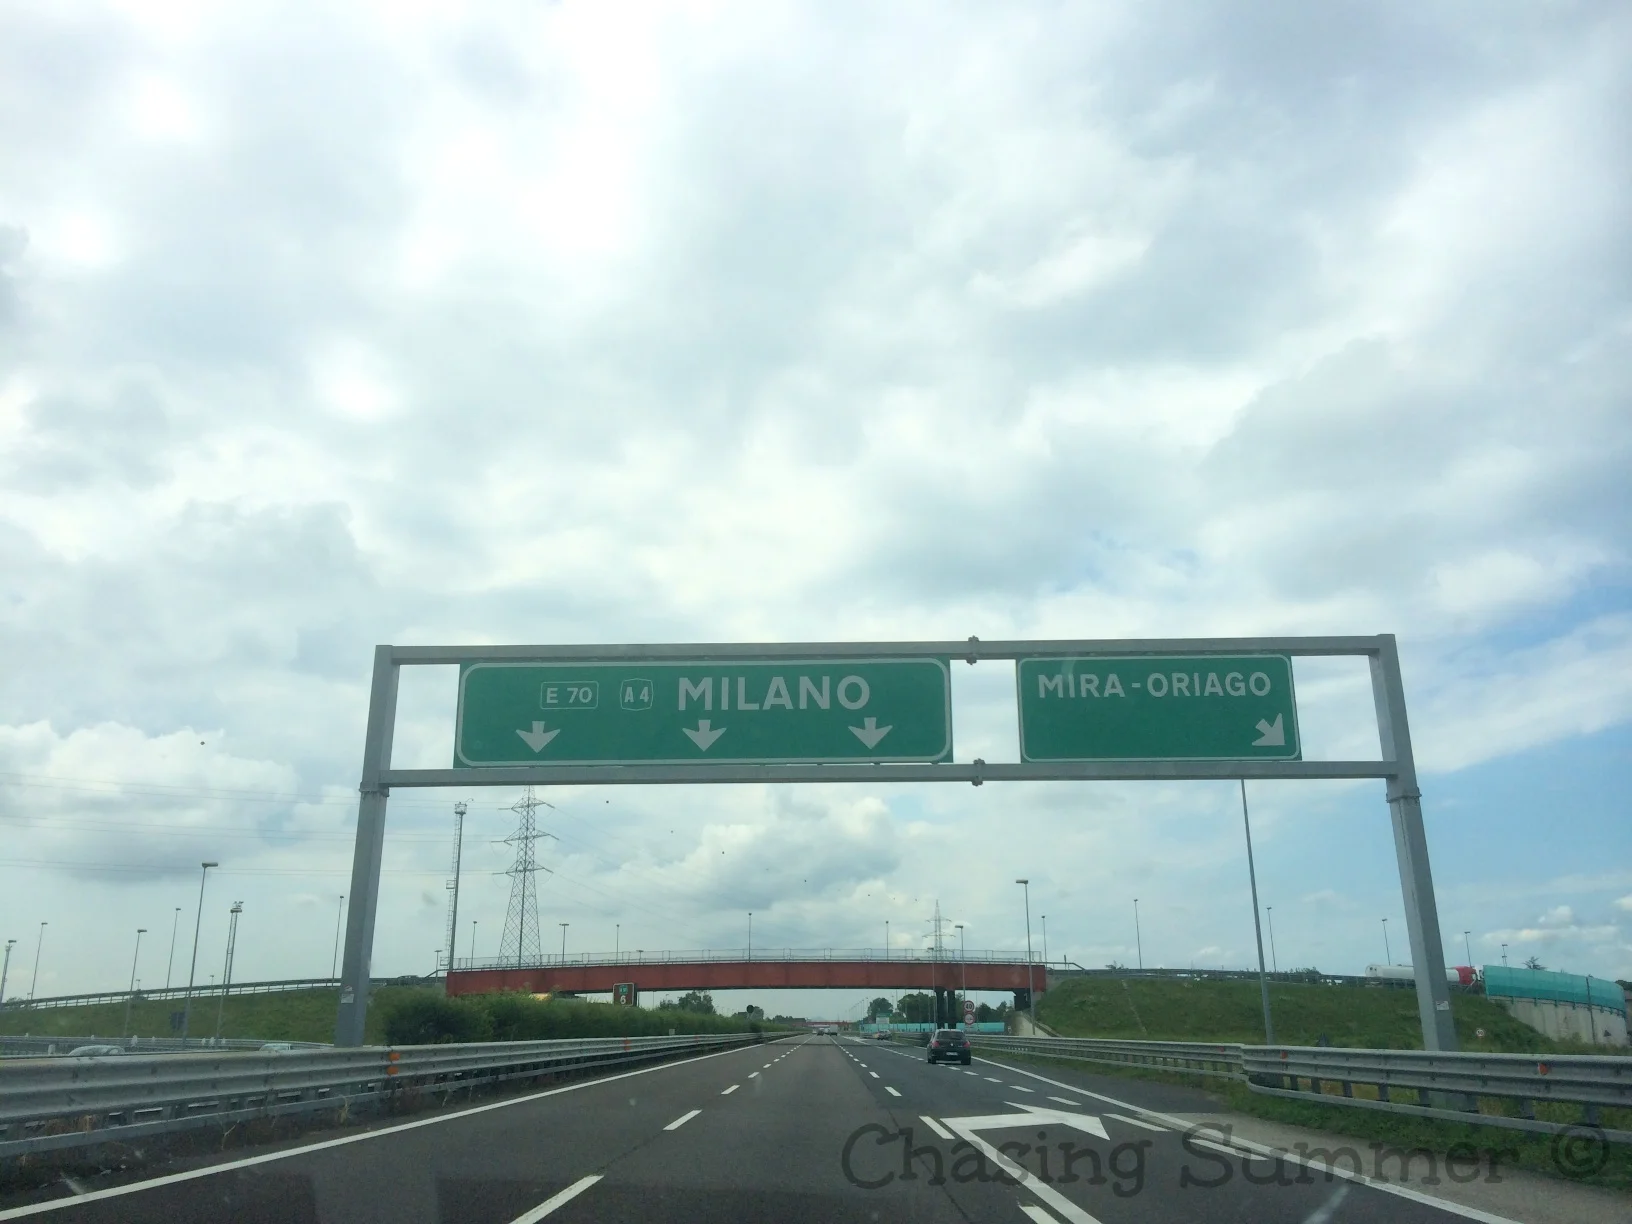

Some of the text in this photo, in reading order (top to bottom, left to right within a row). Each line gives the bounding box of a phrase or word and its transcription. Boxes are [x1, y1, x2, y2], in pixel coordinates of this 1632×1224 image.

[546, 687, 593, 704] E 70
[678, 675, 871, 711] MILANO
